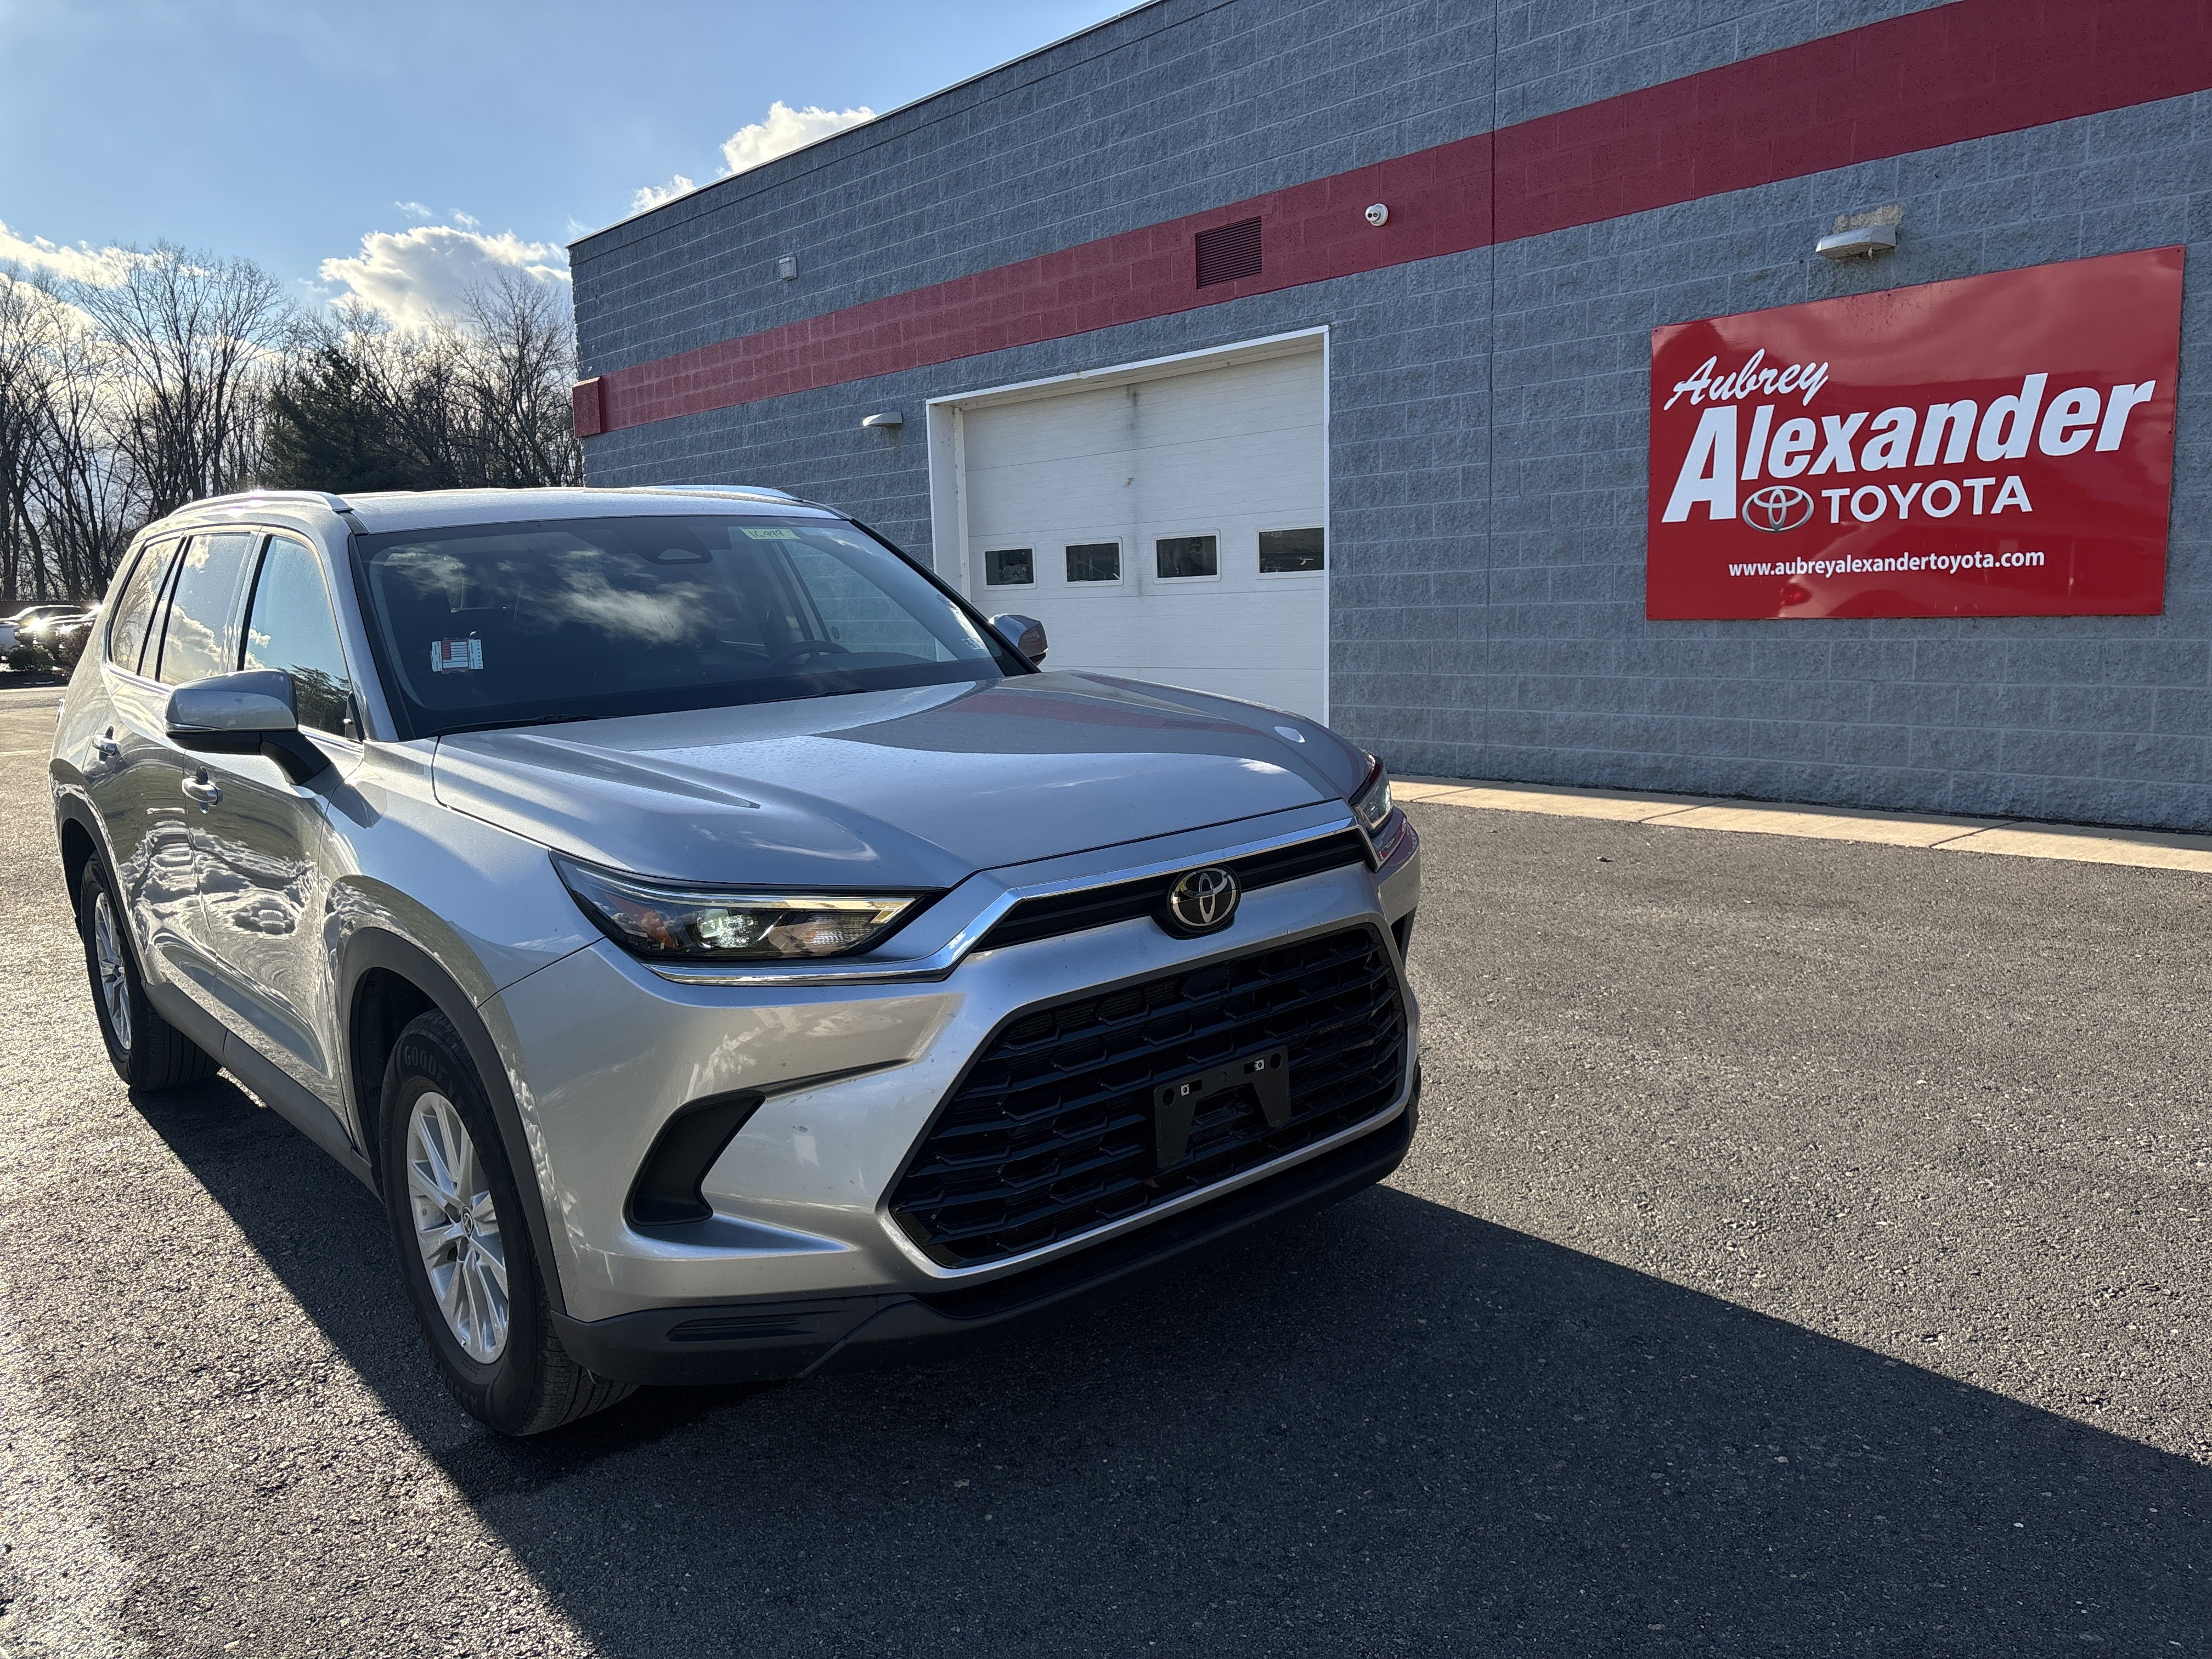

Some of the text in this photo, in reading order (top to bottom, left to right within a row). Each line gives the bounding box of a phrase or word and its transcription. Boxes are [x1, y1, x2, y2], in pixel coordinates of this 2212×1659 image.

[1663, 348, 1829, 410] Aubrey
[1661, 373, 2157, 523] Alexander
[1821, 475, 2033, 524] TOYOTA
[1729, 551, 2045, 578] www.aubreyalexandertoyota.com
